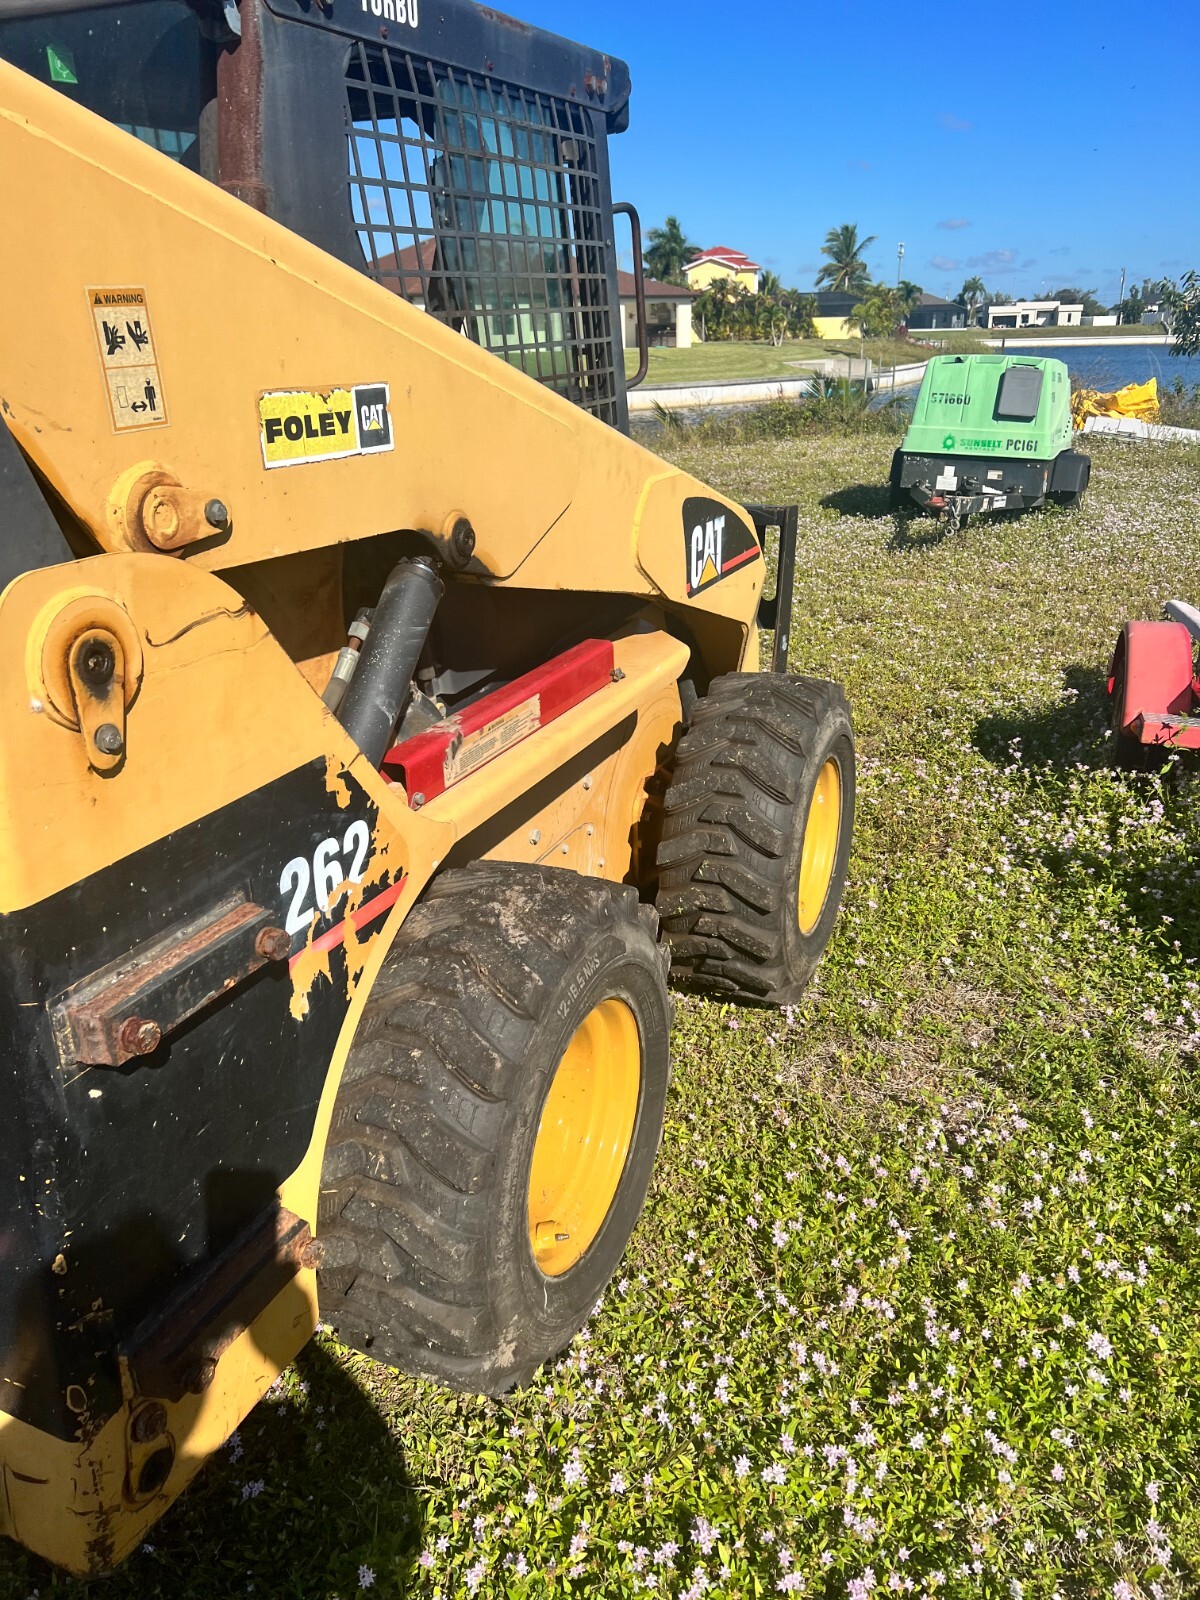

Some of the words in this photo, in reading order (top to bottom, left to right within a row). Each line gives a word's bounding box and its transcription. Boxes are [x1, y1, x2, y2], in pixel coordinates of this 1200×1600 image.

[103, 294, 144, 304] WARNING
[930, 392, 971, 406] 571660
[264, 410, 352, 444] FOLEY
[360, 403, 384, 434] CAT
[960, 438, 1002, 448] SUNBELT
[691, 515, 726, 589] CAT
[280, 819, 370, 937] 262
